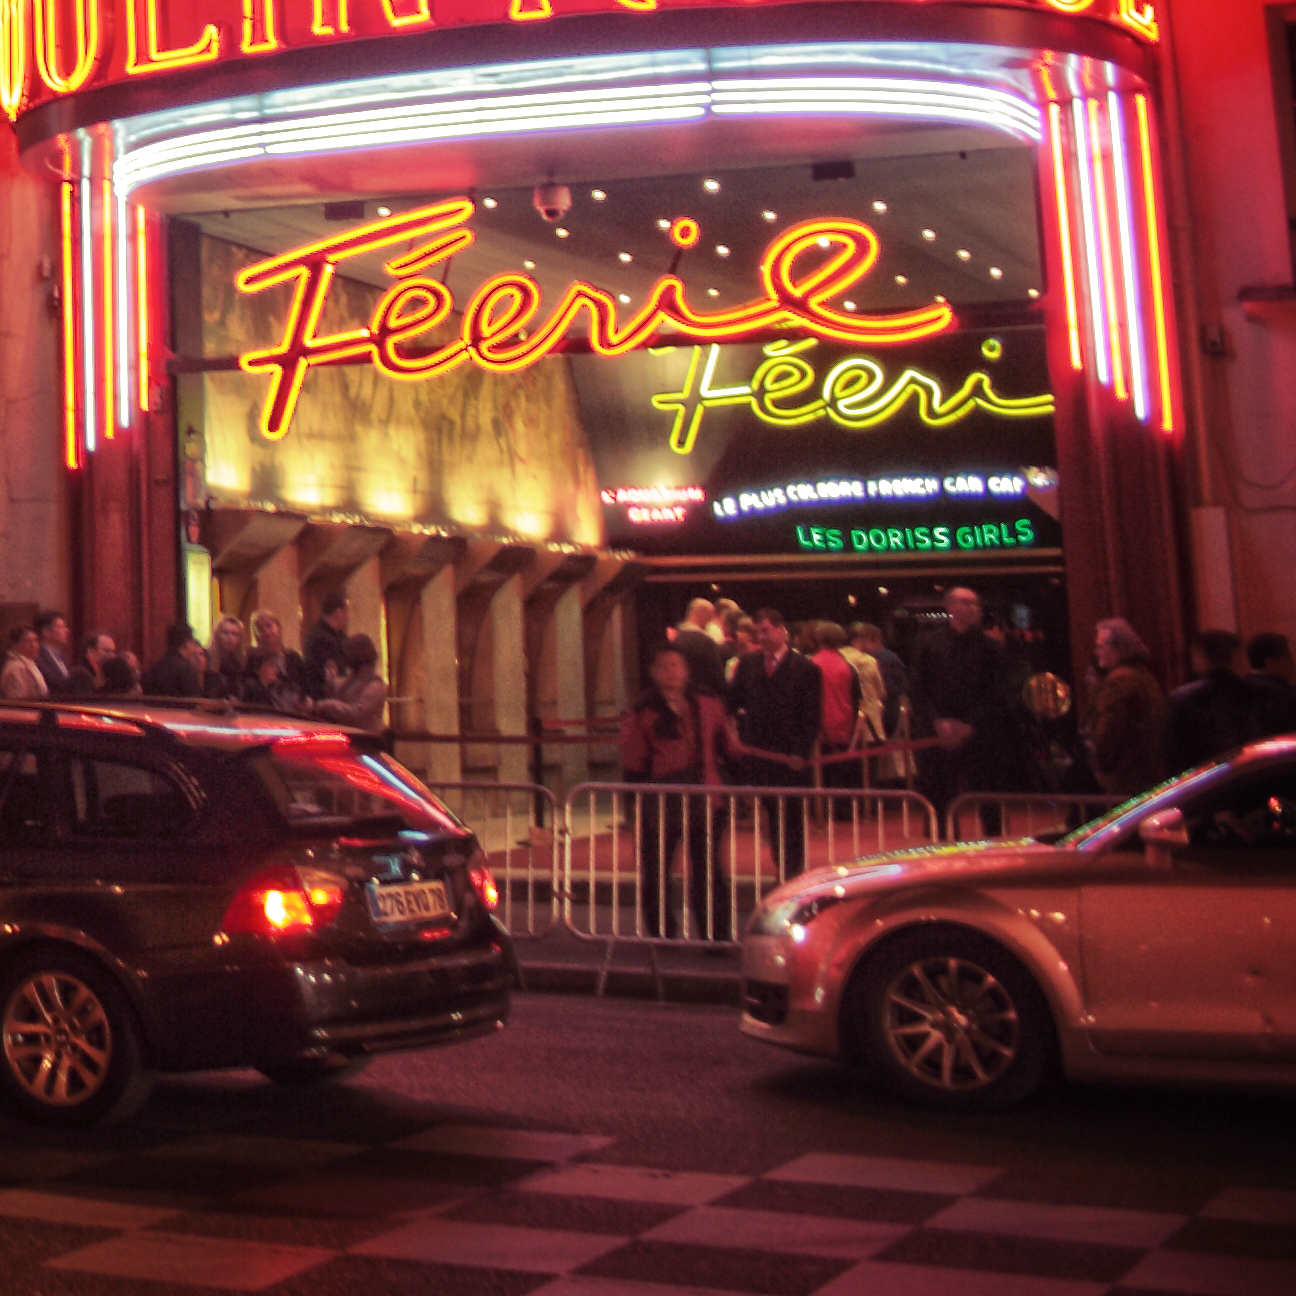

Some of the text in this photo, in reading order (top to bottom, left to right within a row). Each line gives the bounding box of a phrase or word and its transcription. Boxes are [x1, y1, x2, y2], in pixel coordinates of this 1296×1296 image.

[650, 334, 1056, 455] Féeri
[738, 487, 787, 512] PLUS
[794, 517, 1036, 552] LES DORISS GIRLS
